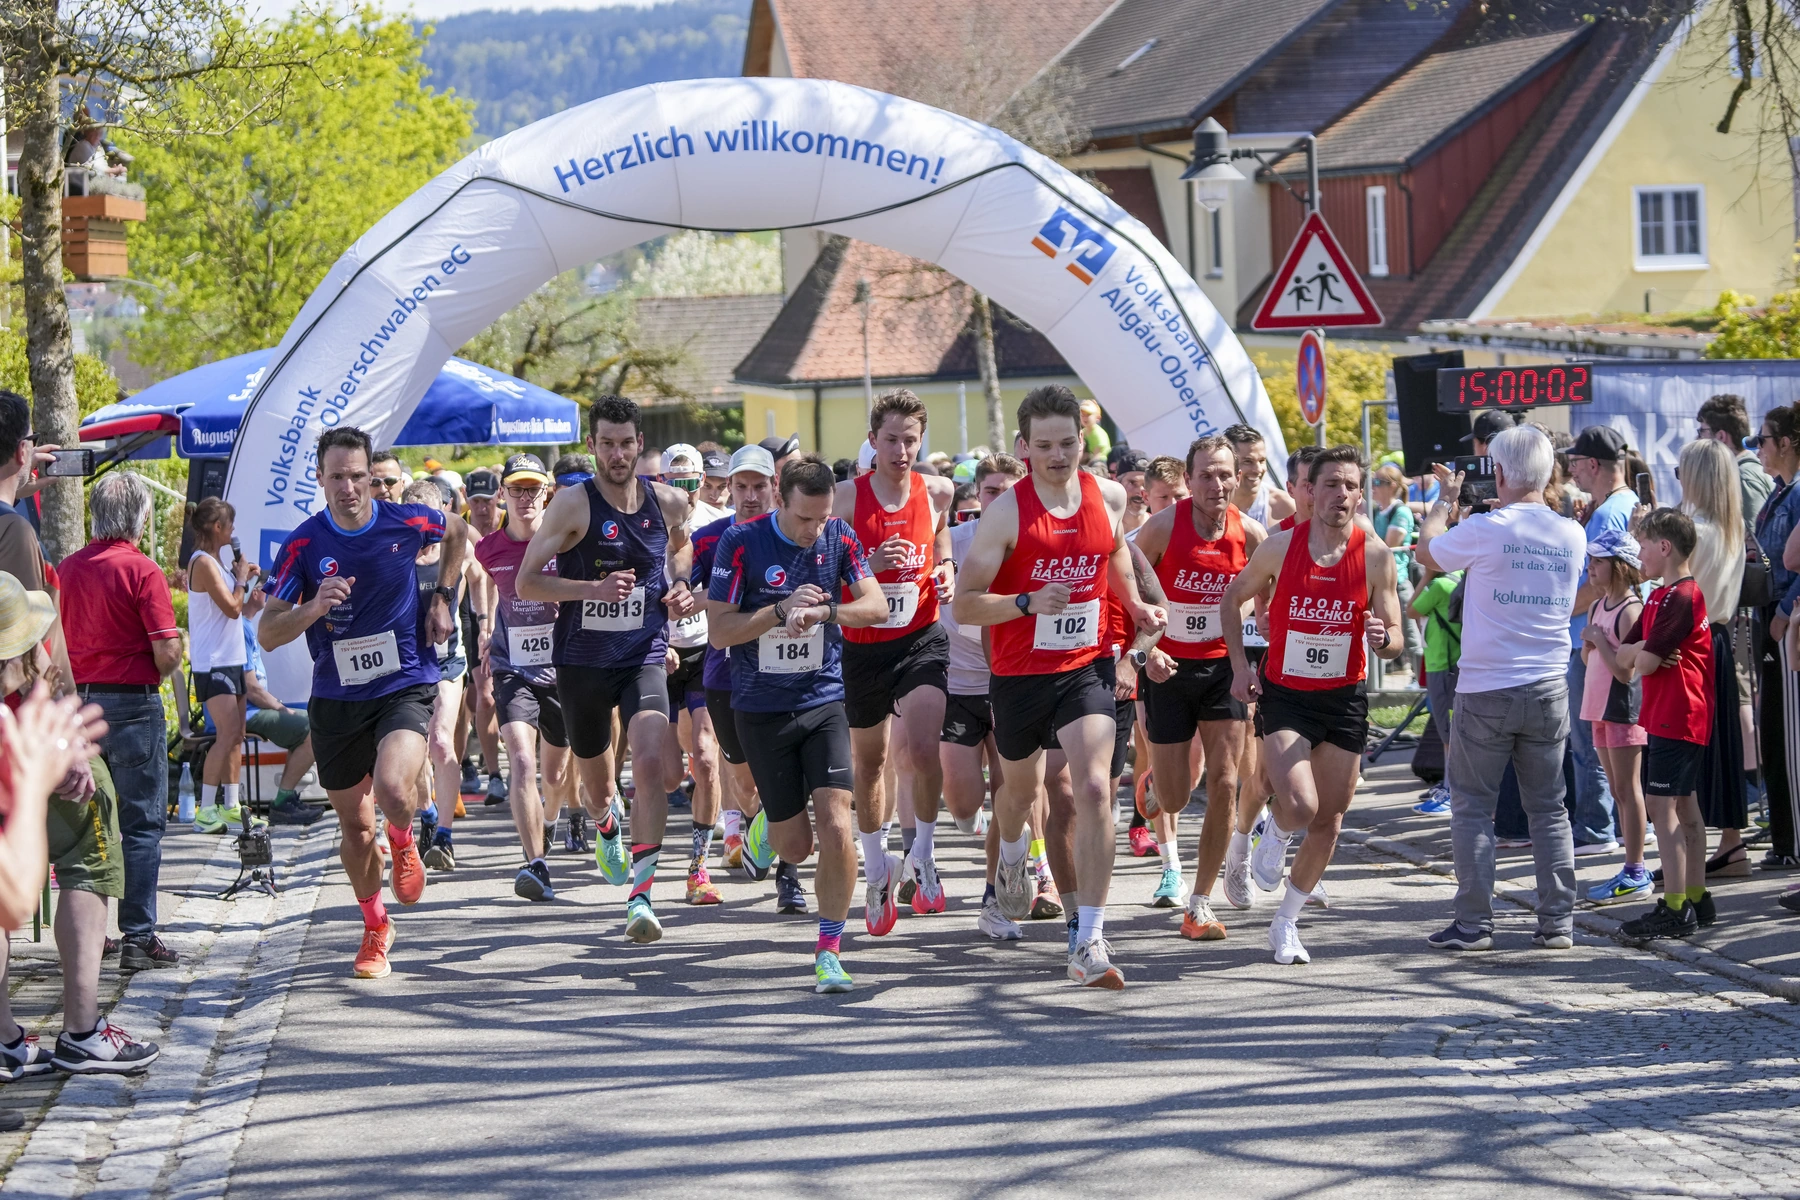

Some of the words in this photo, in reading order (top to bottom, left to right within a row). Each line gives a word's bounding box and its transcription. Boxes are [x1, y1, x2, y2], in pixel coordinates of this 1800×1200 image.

[553, 125, 695, 193] Herzlich
[704, 120, 945, 184] willkommen!
[441, 244, 472, 275] eG
[1125, 265, 1209, 371] Volksbank
[1459, 367, 1588, 407] 15:00:02
[265, 385, 321, 507] Volksbank
[1503, 544, 1521, 554] Die
[1523, 545, 1573, 558] Nachricht
[1035, 554, 1101, 569] SPORT
[1512, 560, 1524, 569] ist
[1527, 561, 1544, 571] das
[1547, 562, 1567, 573] Ziel
[1031, 565, 1097, 580] HASCHKO
[1177, 569, 1237, 583] SPORT
[1310, 574, 1336, 582] SALOMON
[1290, 596, 1356, 612] SPORT
[1493, 588, 1571, 607] kolumna.org
[512, 605, 545, 613] Marathon
[584, 600, 642, 618] 20913
[1289, 606, 1353, 622] HASCHKO
[1054, 617, 1087, 635] 102
[1185, 616, 1207, 630] 98
[521, 636, 550, 652] 426
[776, 643, 809, 660] 184
[350, 651, 384, 672] 180
[1306, 647, 1330, 664] 96
